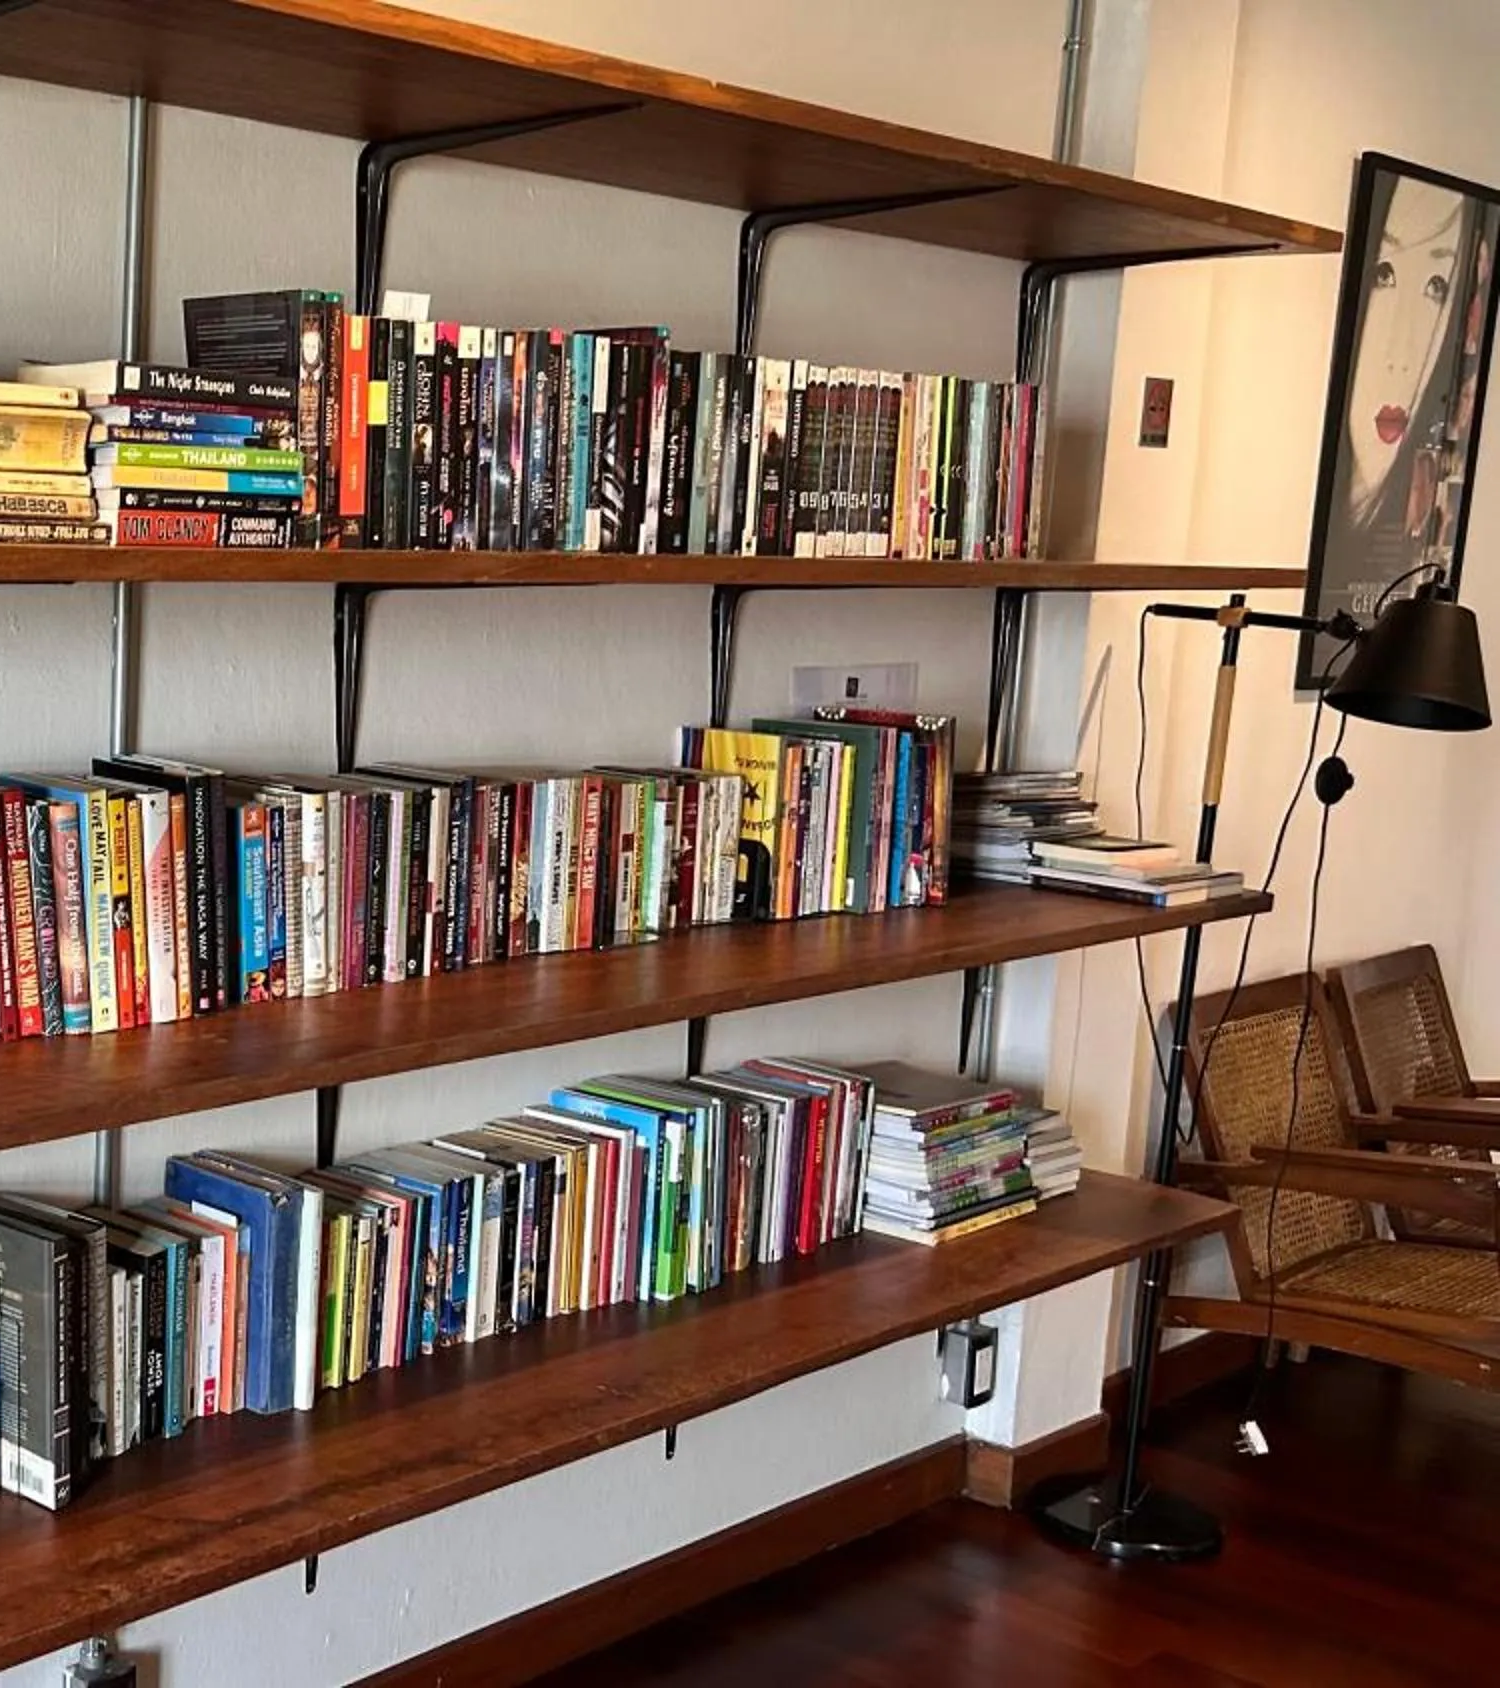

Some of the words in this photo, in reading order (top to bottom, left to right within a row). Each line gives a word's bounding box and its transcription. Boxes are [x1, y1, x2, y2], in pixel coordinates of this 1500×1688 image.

[150, 371, 164, 387] The
[160, 412, 196, 427] Bangkok
[181, 451, 247, 467] THAILAND
[123, 518, 150, 541] TOM
[157, 518, 209, 541] CLANCY
[231, 517, 277, 532] COMMAND
[91, 799, 103, 829] LOVE
[586, 791, 598, 823] WHAT
[4, 803, 17, 855] PHILLIPS
[194, 787, 206, 865] INNOVATION
[65, 839, 77, 868] One
[94, 831, 107, 857] MAY
[451, 827, 460, 862] EVERY
[66, 871, 81, 902] Half
[93, 859, 105, 884] FAIL
[175, 850, 187, 923] INSTANT
[197, 868, 206, 890] THE
[253, 847, 265, 921] Southeast
[11, 859, 31, 925] ANOTHER
[447, 864, 457, 918] EXQUISITE
[96, 893, 110, 957] MATTHEW
[161, 876, 172, 953] INVESTIGATION
[197, 895, 207, 928] NASA
[17, 928, 36, 974] MAN'S
[199, 932, 208, 960] WAY
[253, 925, 264, 957] Asia
[445, 921, 455, 954] THING
[178, 927, 188, 992] EXPERT
[21, 976, 39, 1008] WAR
[95, 961, 112, 1000] QUICK
[456, 1208, 470, 1274] Thailand
[147, 1349, 155, 1397] TOWLES
[154, 1352, 163, 1387] AMOS
